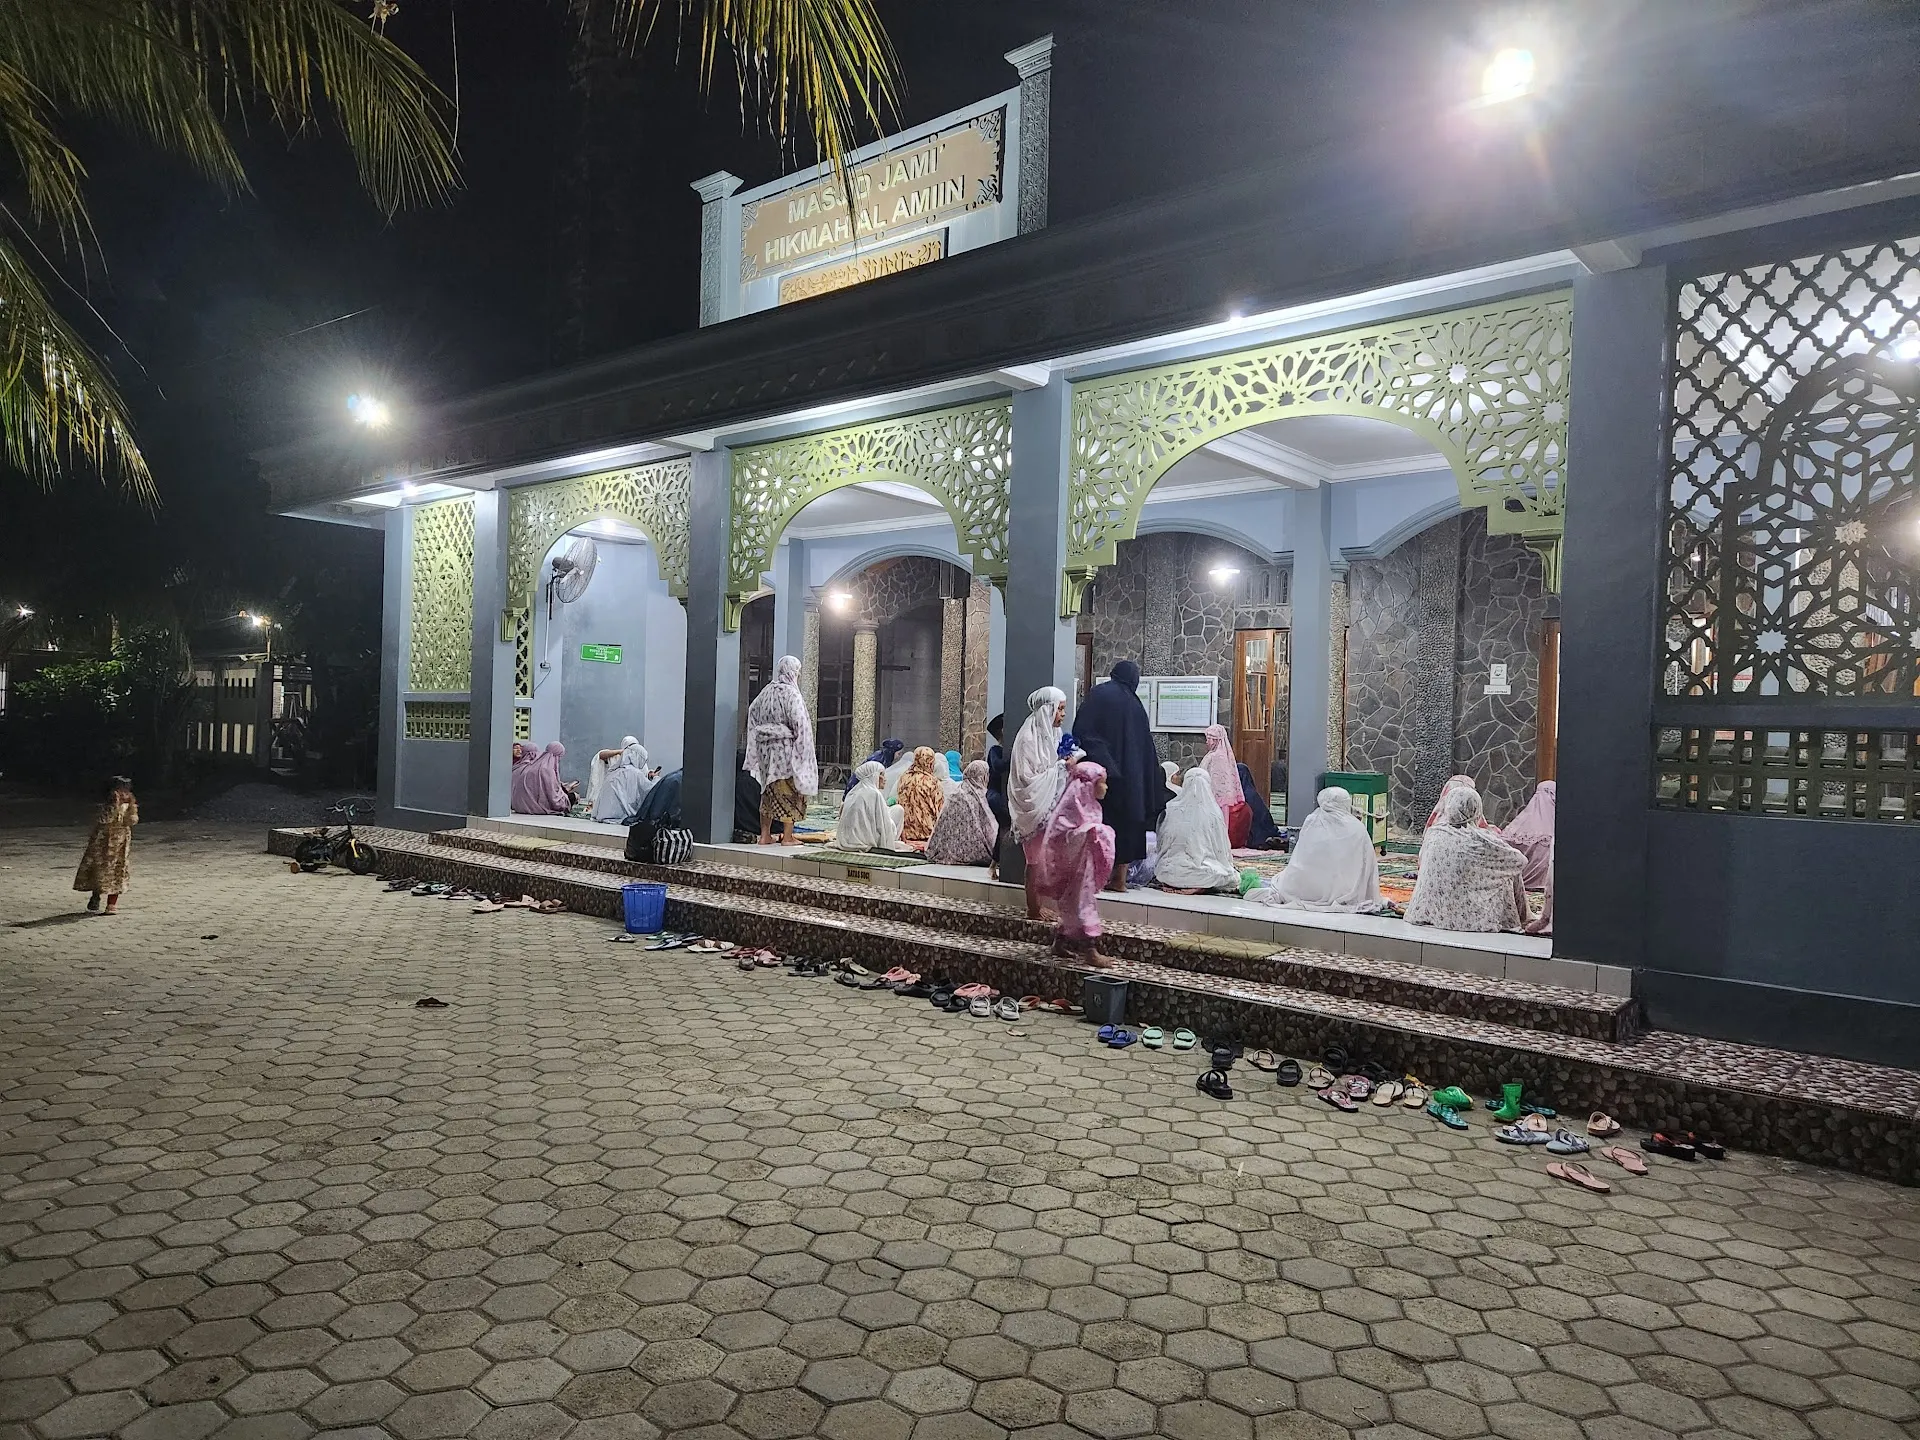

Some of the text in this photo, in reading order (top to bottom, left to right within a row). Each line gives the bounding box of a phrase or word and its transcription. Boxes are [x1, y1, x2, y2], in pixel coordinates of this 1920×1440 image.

[765, 174, 965, 264] HIKMAH AL AMIIN
[788, 173, 873, 223] MASJD
